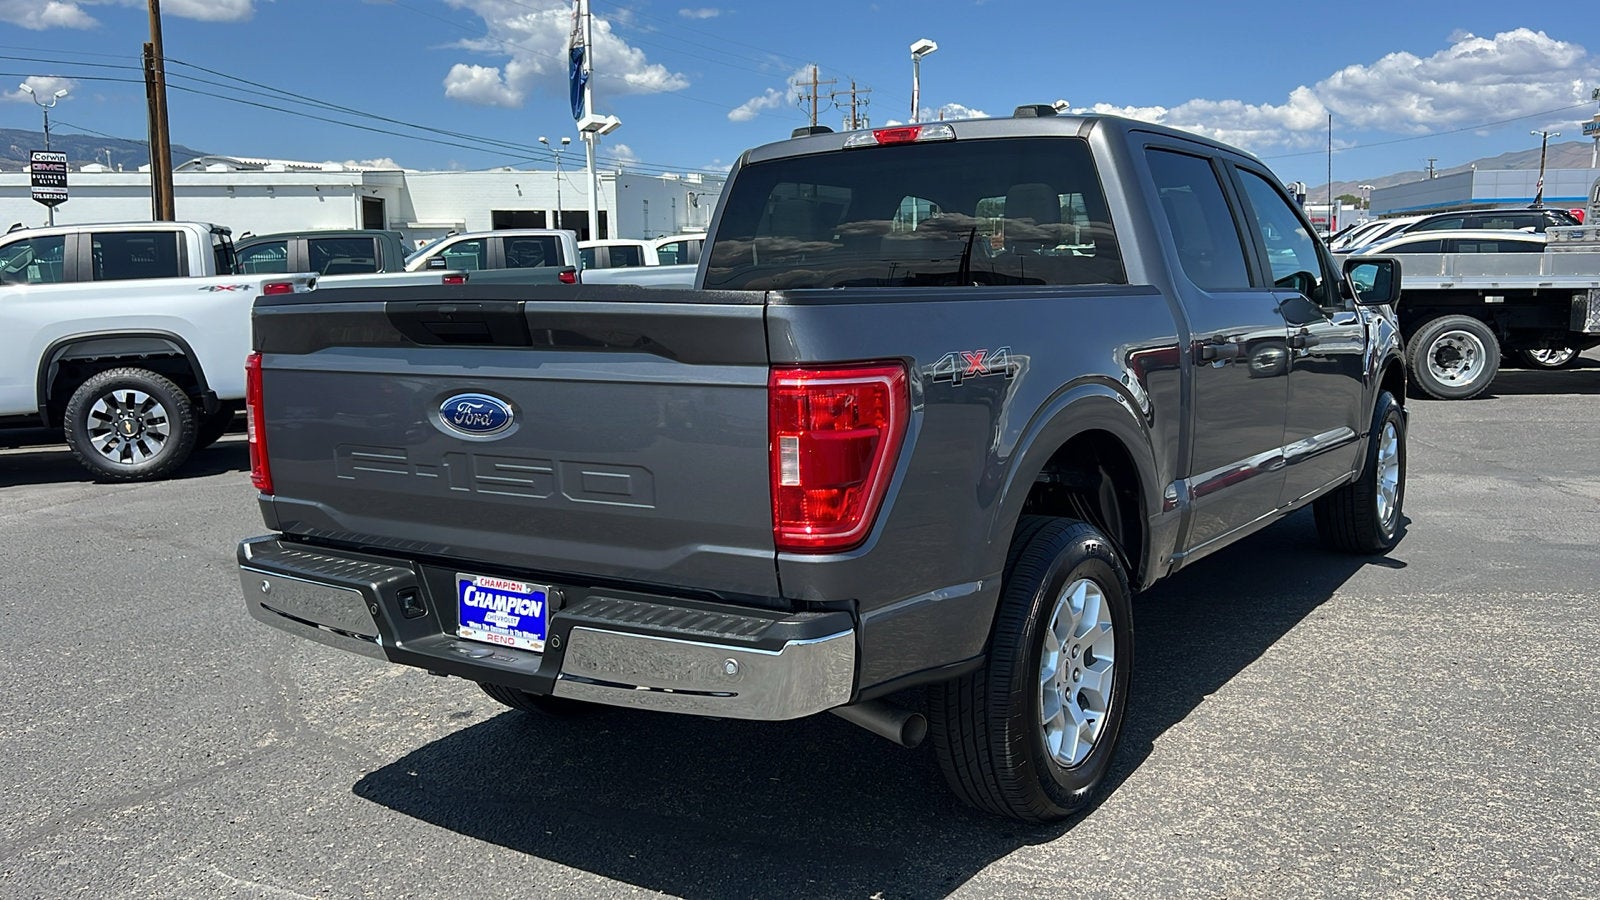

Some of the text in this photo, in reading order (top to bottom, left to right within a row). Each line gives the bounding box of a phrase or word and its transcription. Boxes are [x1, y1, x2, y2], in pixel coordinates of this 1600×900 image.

[34, 153, 65, 161] Corwin
[32, 163, 65, 171] GMC
[453, 401, 494, 427] Ford
[333, 442, 655, 509] F-150
[480, 578, 523, 592] CHAMPION
[463, 585, 543, 618] CHAMPION
[486, 614, 518, 624] CHEVROLET
[486, 633, 516, 646] RENO
